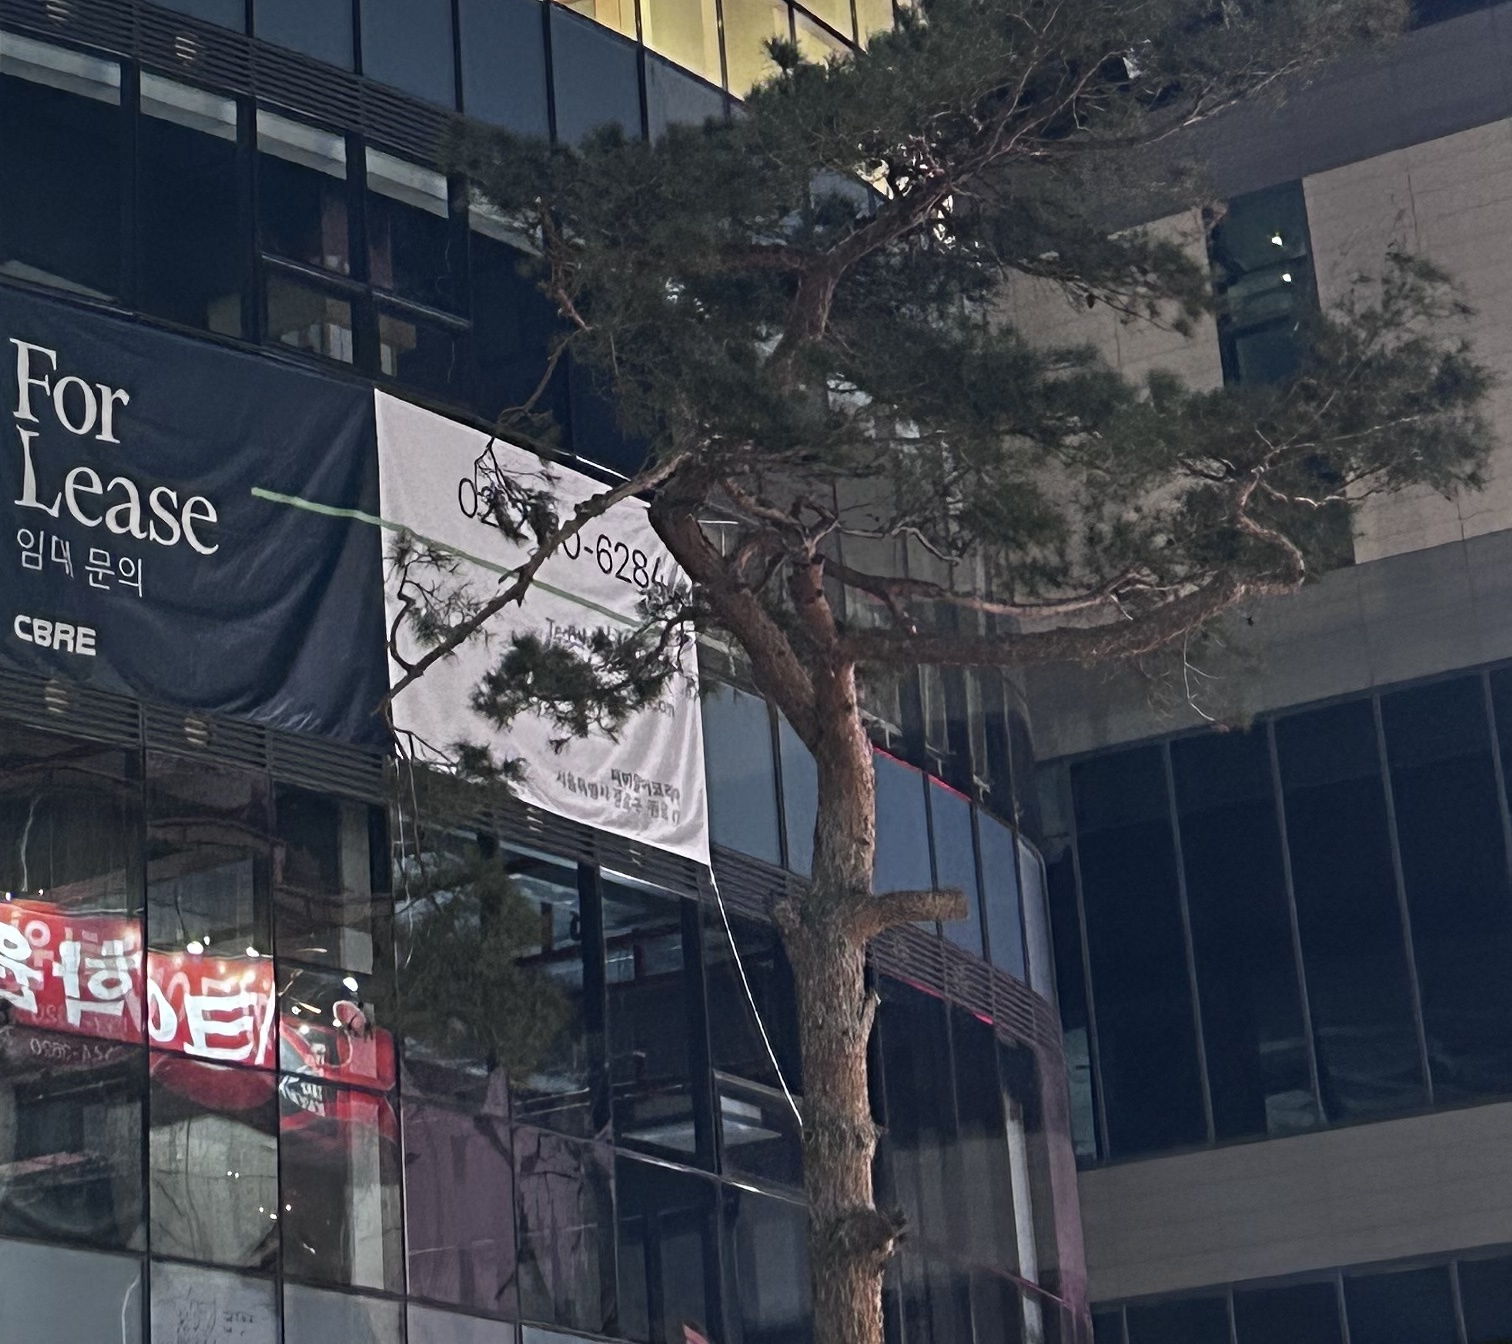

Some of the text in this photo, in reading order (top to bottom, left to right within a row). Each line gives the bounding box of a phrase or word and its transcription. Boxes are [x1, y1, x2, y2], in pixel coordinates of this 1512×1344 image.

[9, 338, 130, 444] For
[14, 424, 219, 555] Lease
[16, 528, 143, 598] 임대 문의
[13, 614, 97, 657] CBRE
